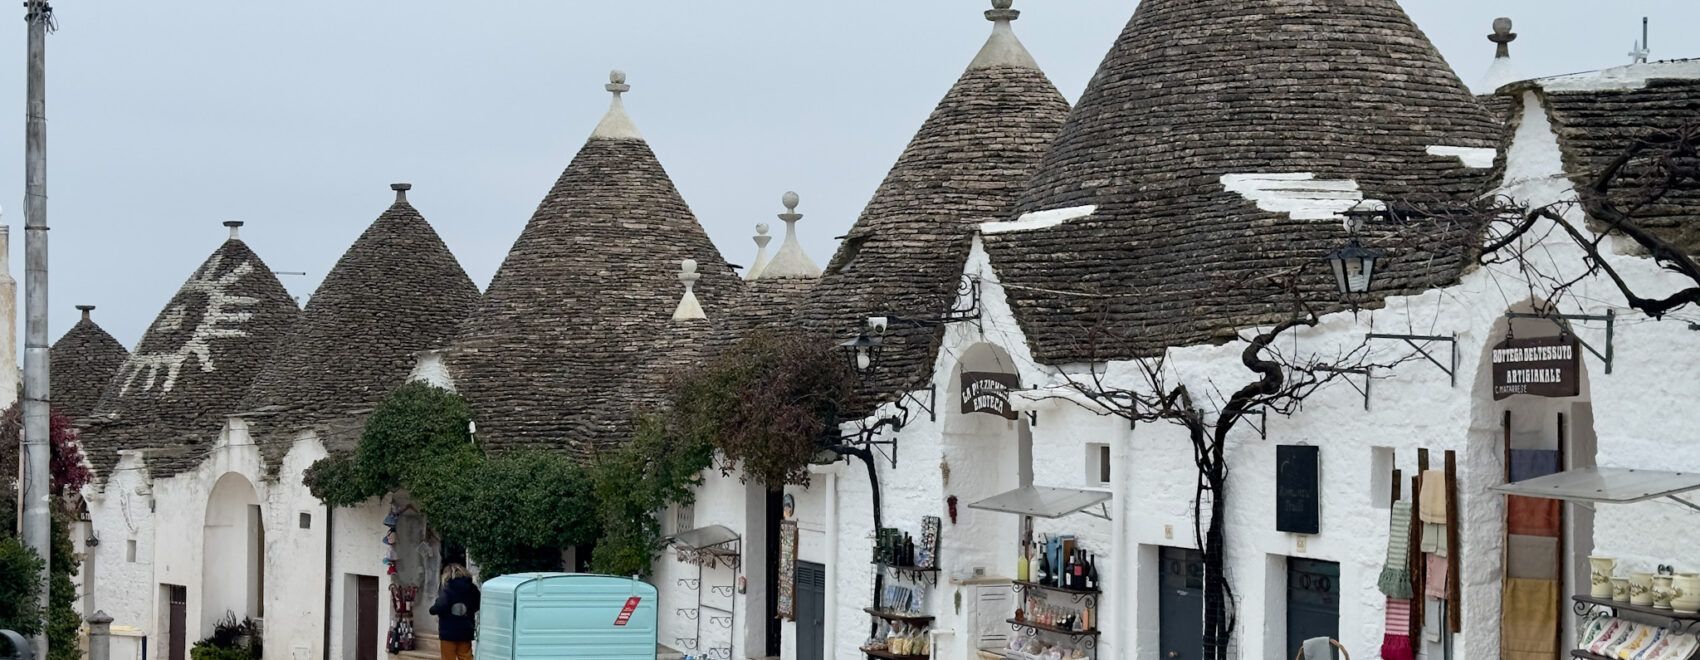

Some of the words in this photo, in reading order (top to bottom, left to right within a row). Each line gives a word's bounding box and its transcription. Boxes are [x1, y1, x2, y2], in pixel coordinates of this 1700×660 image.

[1493, 349, 1523, 363] BOTTEGA
[1507, 369, 1561, 383] ARTIGIANALE
[963, 387, 971, 403] LA
[973, 395, 1003, 414] ENOTECA
